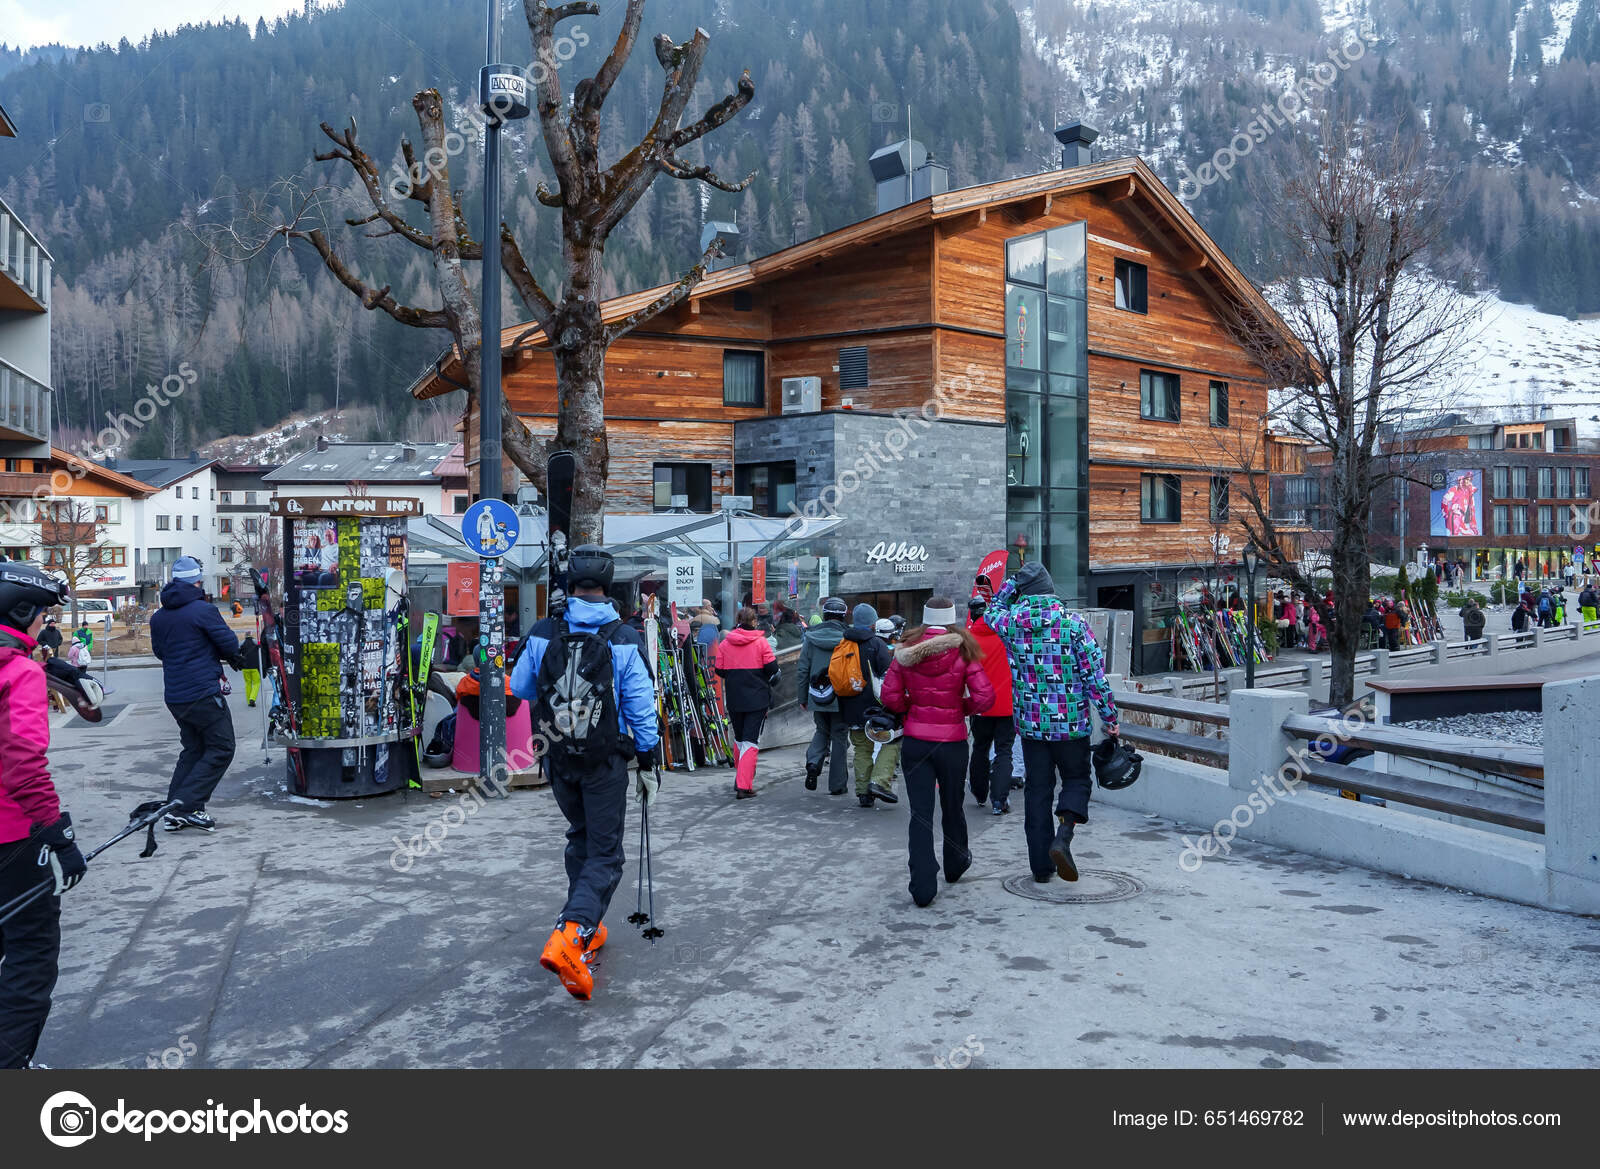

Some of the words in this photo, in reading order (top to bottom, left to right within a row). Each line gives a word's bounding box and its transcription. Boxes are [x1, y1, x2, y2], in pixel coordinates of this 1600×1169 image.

[321, 500, 376, 512] ANTON
[386, 500, 413, 512] INFO
[866, 541, 929, 564] Alber
[676, 566, 695, 576] SKI
[895, 563, 925, 573] FREERIDE
